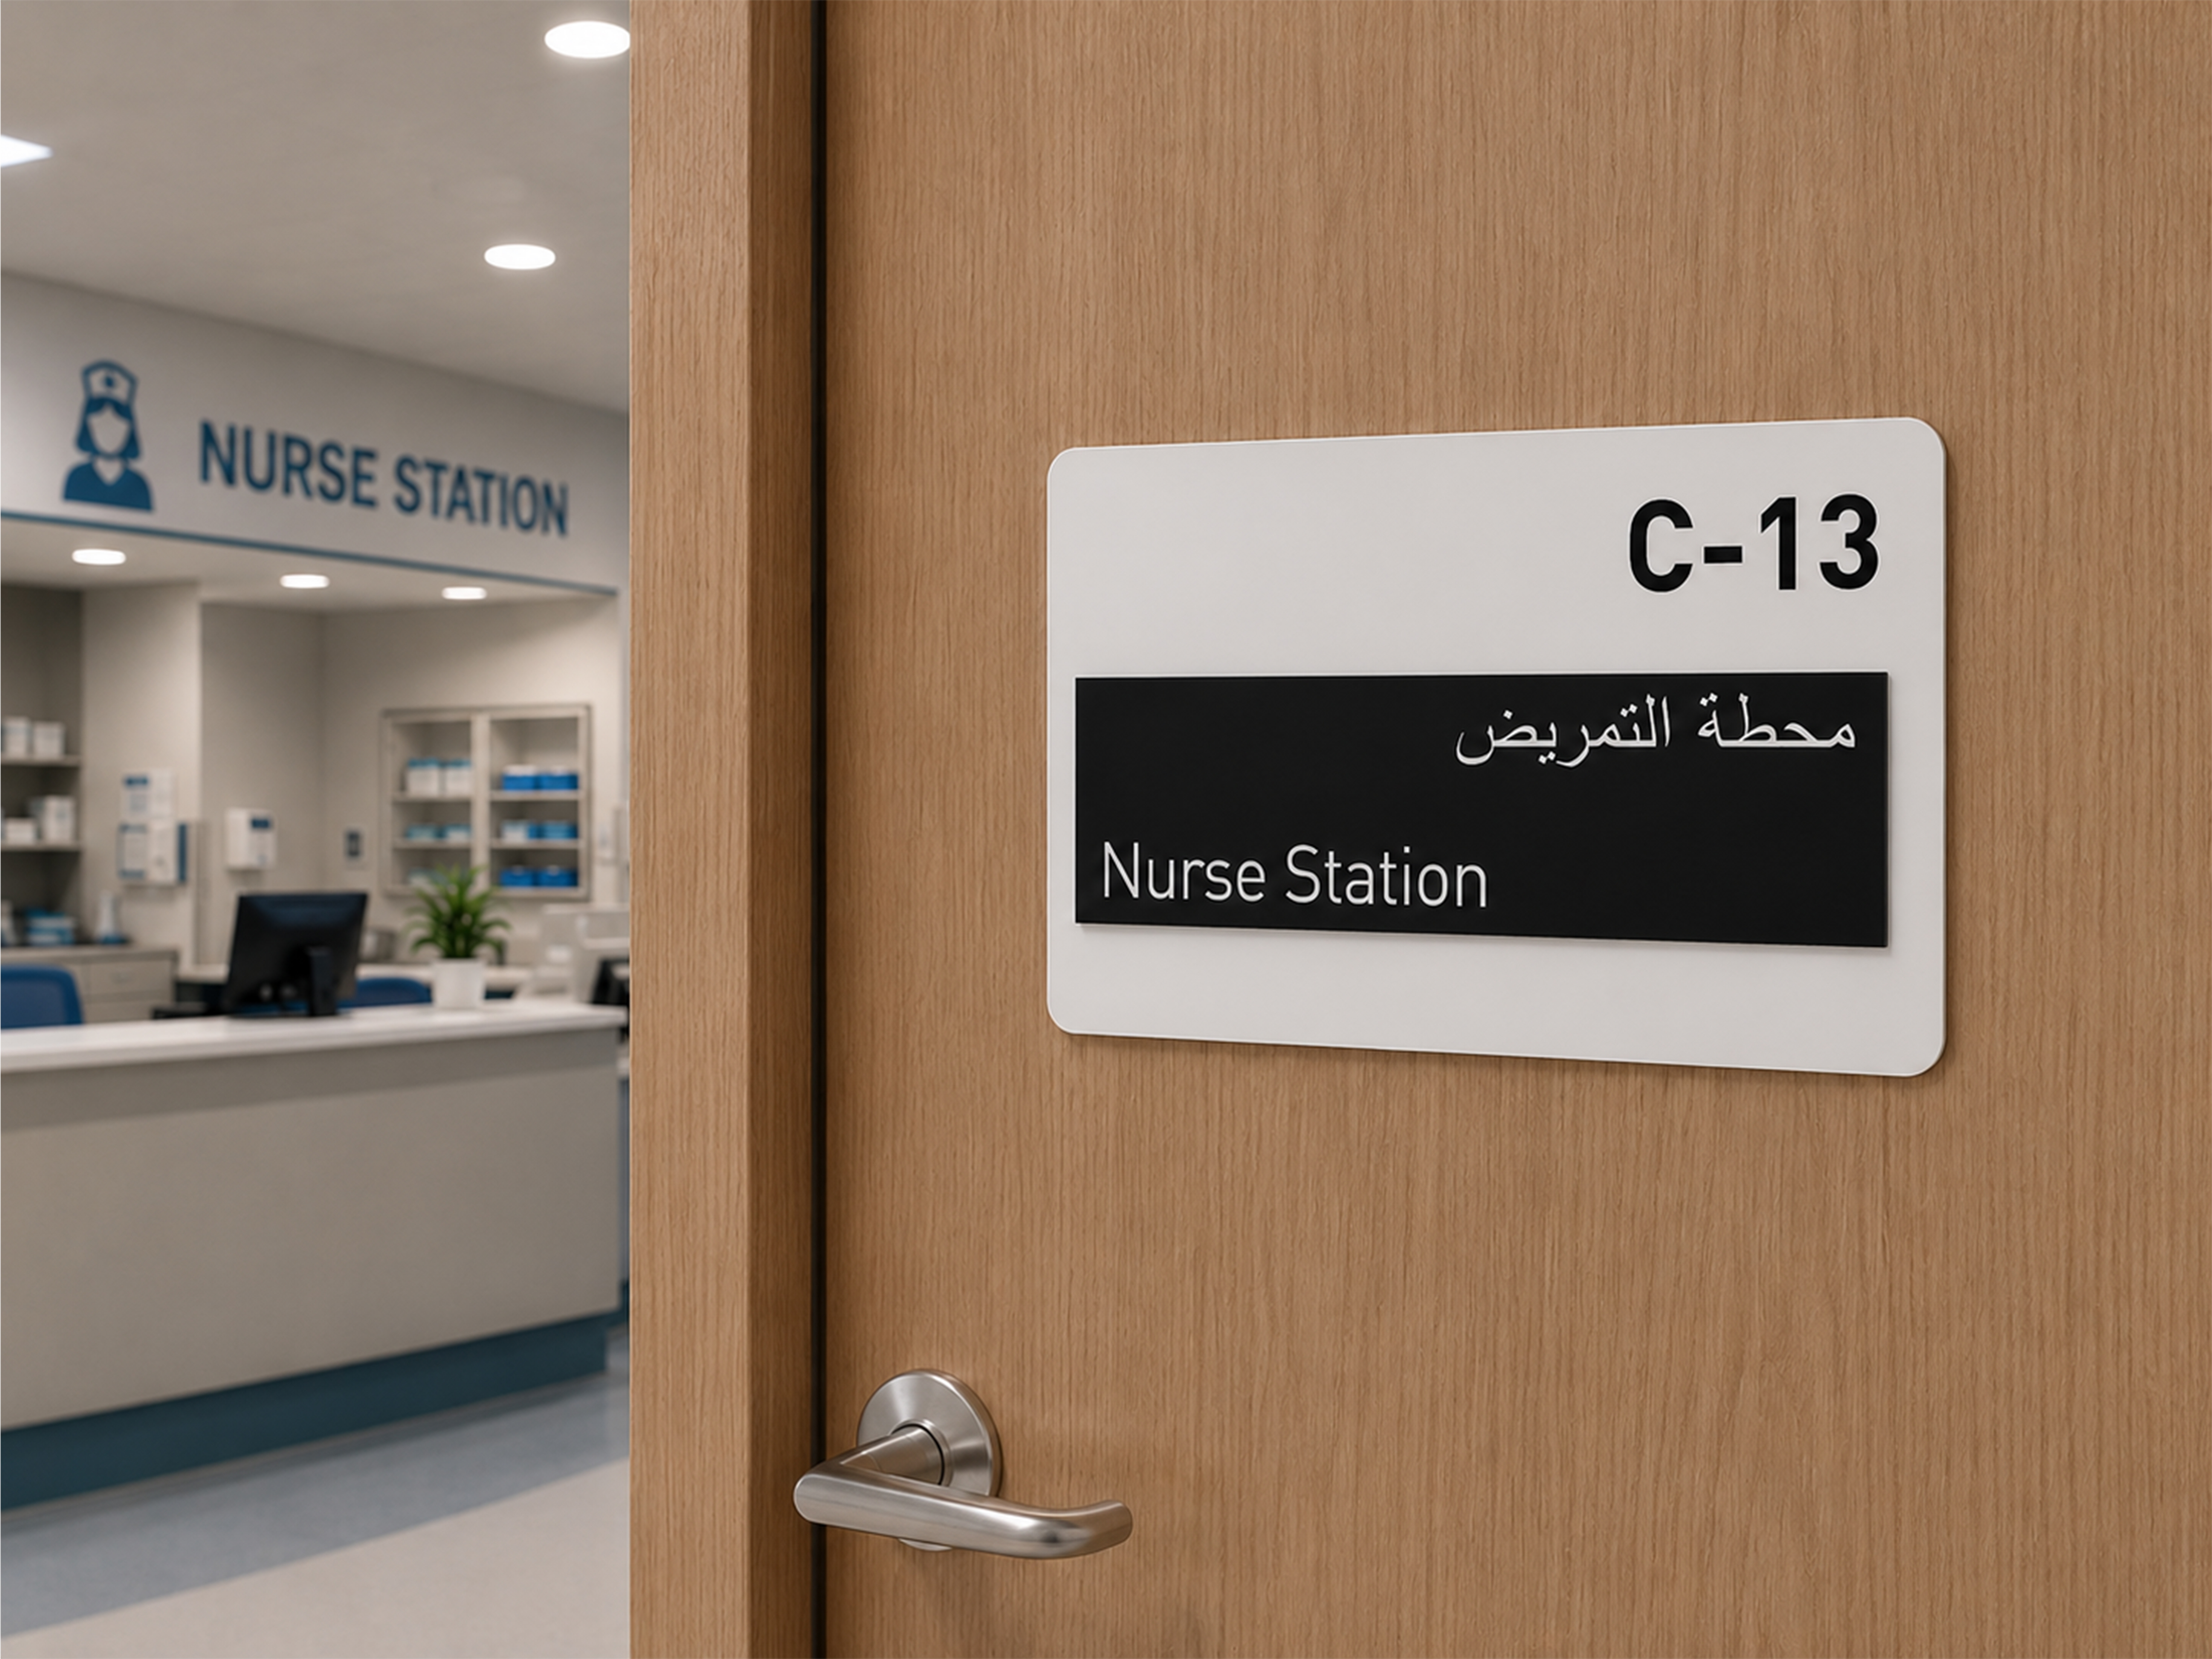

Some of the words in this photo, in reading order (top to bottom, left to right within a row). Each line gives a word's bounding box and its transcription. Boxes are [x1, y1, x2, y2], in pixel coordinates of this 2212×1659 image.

[199, 419, 377, 508] NURSE
[394, 455, 568, 536] STATION
[1629, 493, 1880, 593] C-13
[1456, 693, 1670, 768] التمريض
[1697, 692, 1856, 749] محطة
[1104, 840, 1266, 902] Nurse
[1286, 843, 1487, 908] Station
